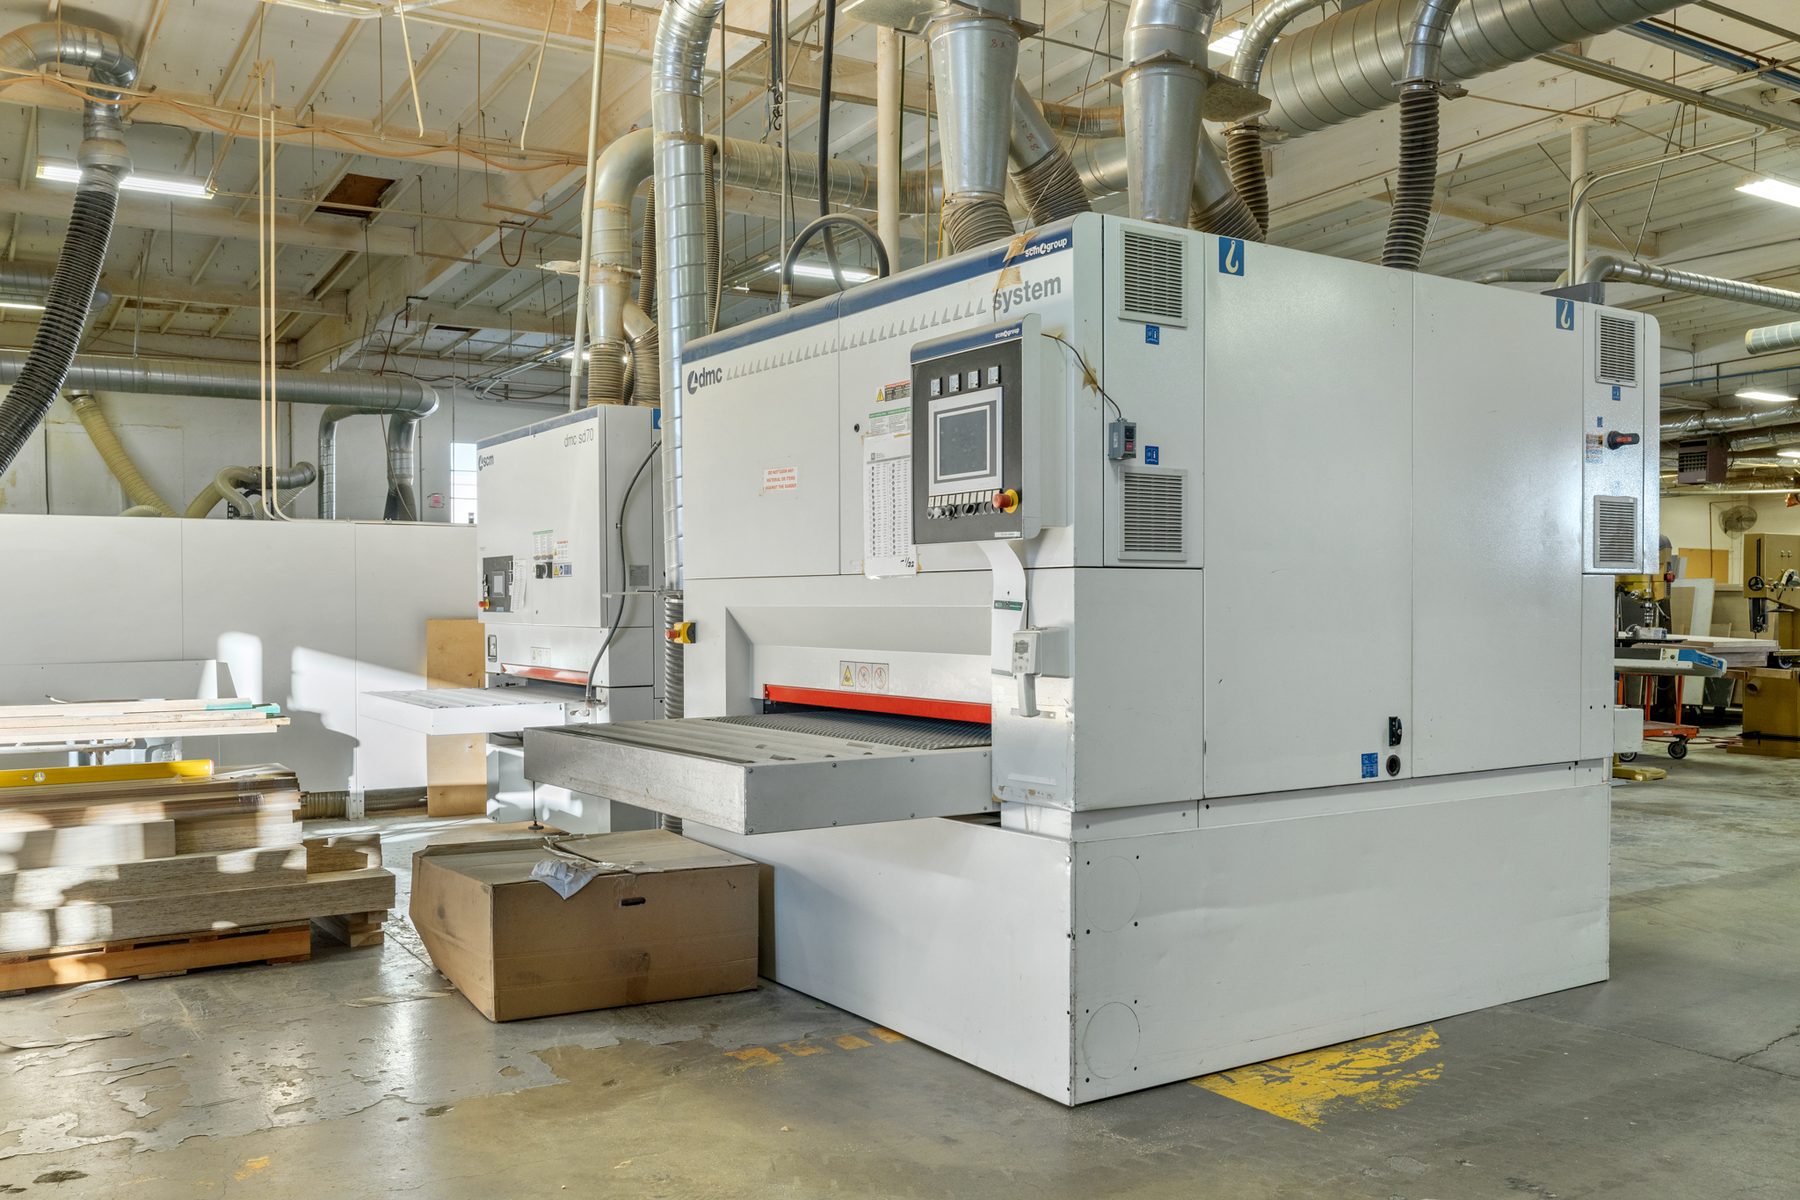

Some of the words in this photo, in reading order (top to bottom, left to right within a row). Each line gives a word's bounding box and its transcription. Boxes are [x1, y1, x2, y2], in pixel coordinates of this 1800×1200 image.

[1046, 238, 1068, 253] group
[993, 277, 1062, 313] system
[699, 367, 722, 388] dmc
[563, 432, 577, 448] dmc
[483, 455, 494, 468] scm
